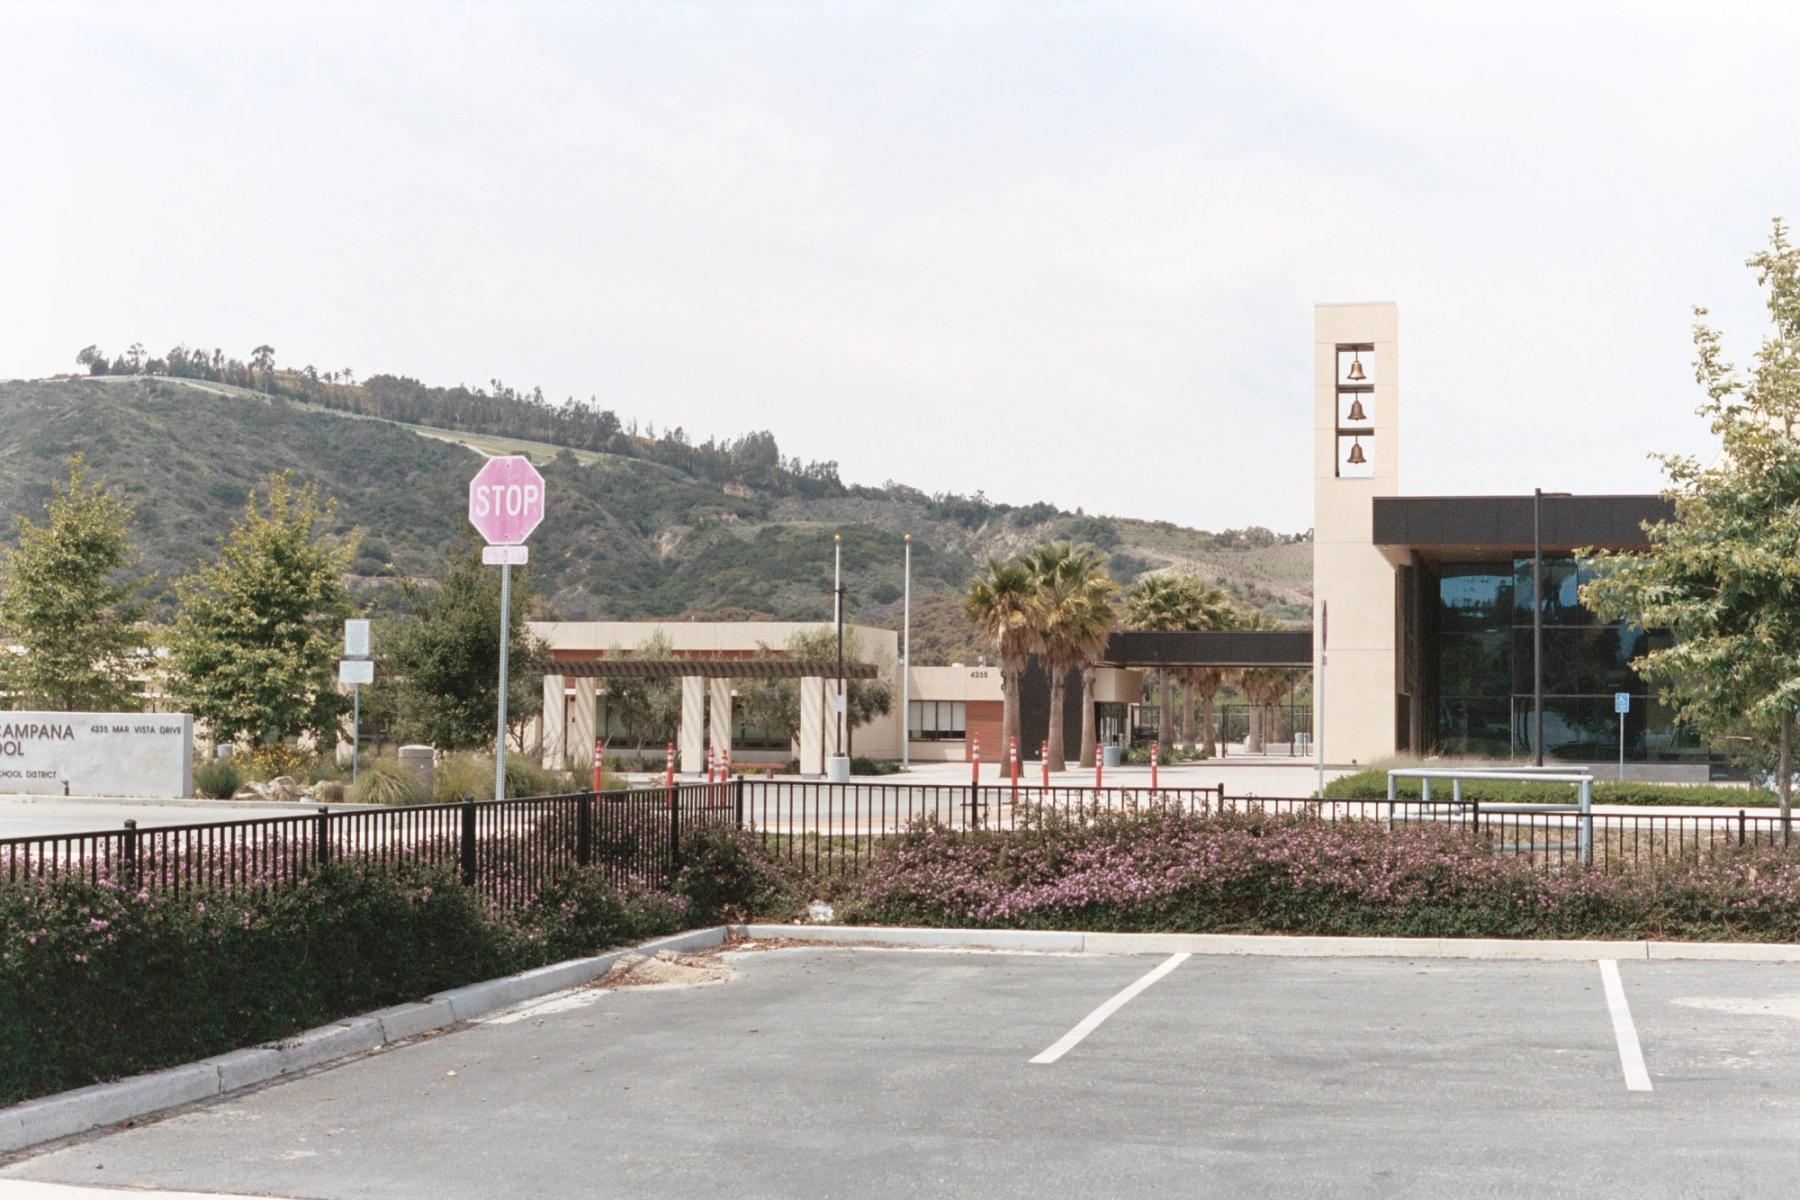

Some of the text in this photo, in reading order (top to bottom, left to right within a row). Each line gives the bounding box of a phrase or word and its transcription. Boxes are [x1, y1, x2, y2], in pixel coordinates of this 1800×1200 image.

[475, 484, 539, 517] STOP
[0, 724, 74, 739] AMPANA
[90, 725, 182, 735] 4235 MAR VISTA DRIVE
[0, 741, 24, 756] OL
[26, 770, 56, 779] DISTRICT
